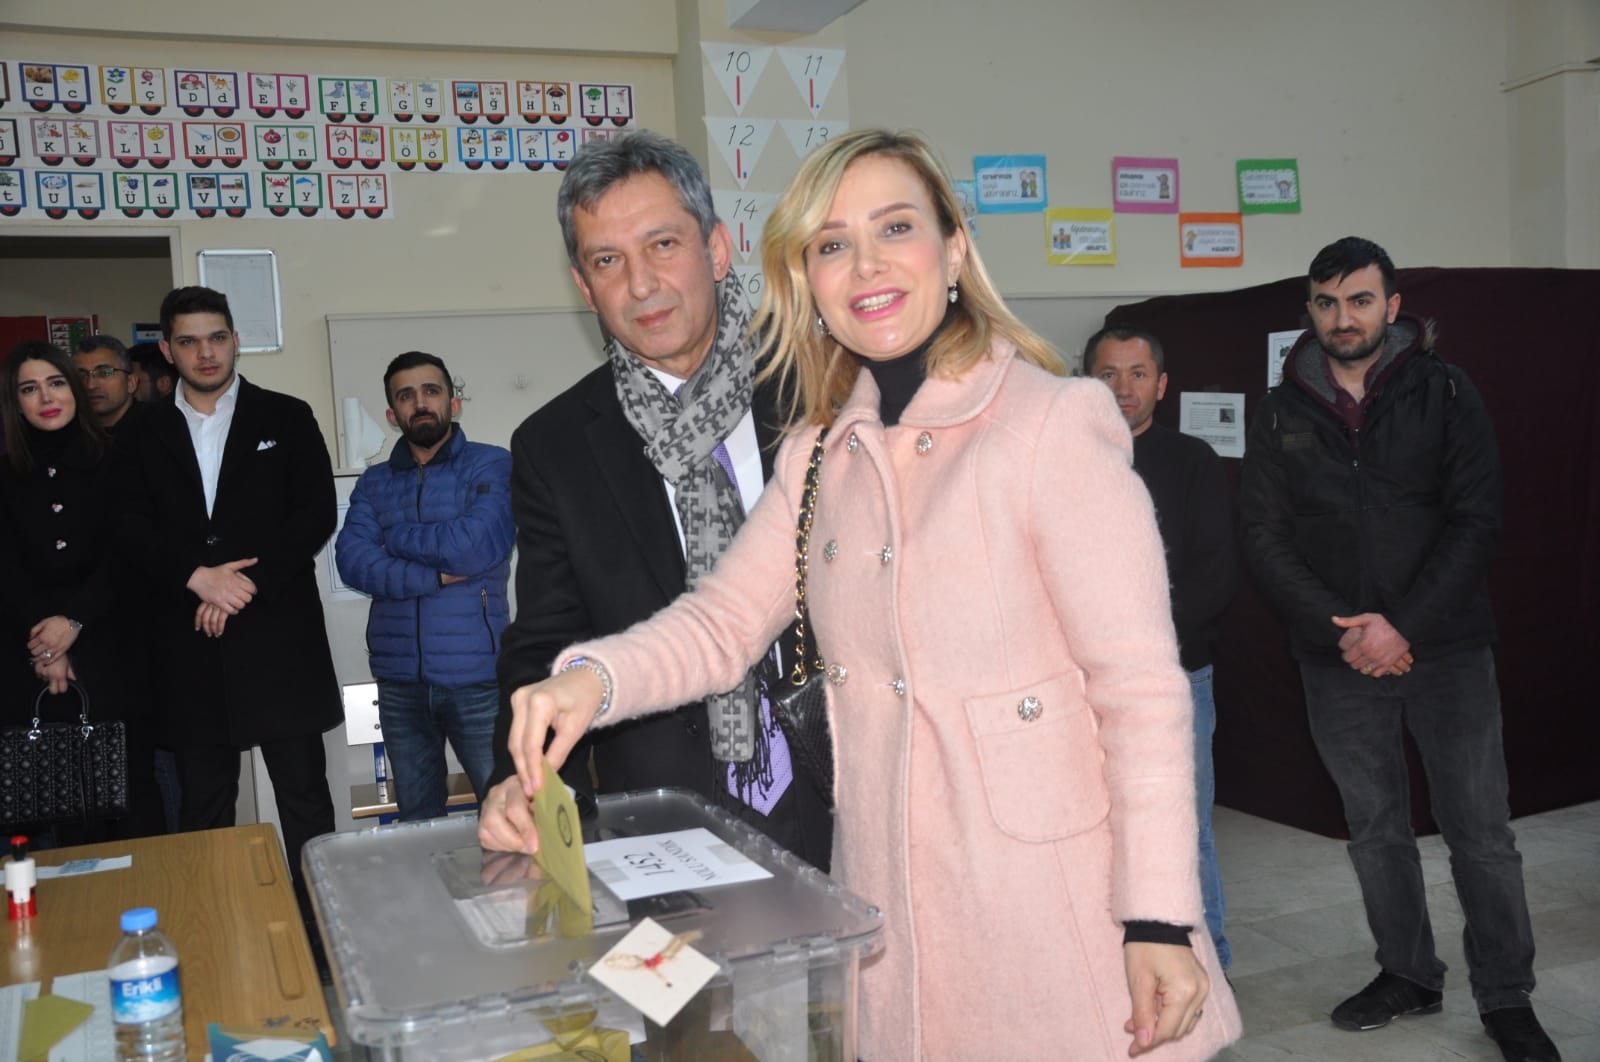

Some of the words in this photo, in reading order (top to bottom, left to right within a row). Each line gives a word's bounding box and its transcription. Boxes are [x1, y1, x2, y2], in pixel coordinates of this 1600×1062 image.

[726, 50, 751, 72] 10
[804, 55, 823, 75] 11
[32, 85, 44, 97] C
[106, 86, 117, 101] Ç
[188, 92, 198, 103] D
[217, 92, 228, 104] d
[258, 94, 268, 105] E
[288, 97, 298, 106] e
[398, 99, 408, 110] G
[424, 97, 433, 108] g
[329, 101, 339, 112] F
[359, 101, 367, 112] f
[526, 100, 535, 111] H
[552, 101, 561, 112] h
[728, 124, 755, 146] 12
[805, 127, 829, 148] 13
[43, 141, 55, 153] K
[77, 141, 89, 153] k
[120, 143, 131, 154] L
[194, 144, 206, 155] M
[224, 147, 236, 156] m
[266, 146, 276, 157] N
[298, 148, 307, 157] n
[527, 148, 537, 158] R
[558, 150, 566, 159] r
[2, 190, 14, 202] t
[48, 192, 59, 204] U
[81, 195, 93, 205] u
[156, 193, 168, 205] ü
[197, 192, 210, 204] V
[273, 191, 284, 203] Y
[341, 193, 350, 205] Z
[732, 198, 758, 220] 14
